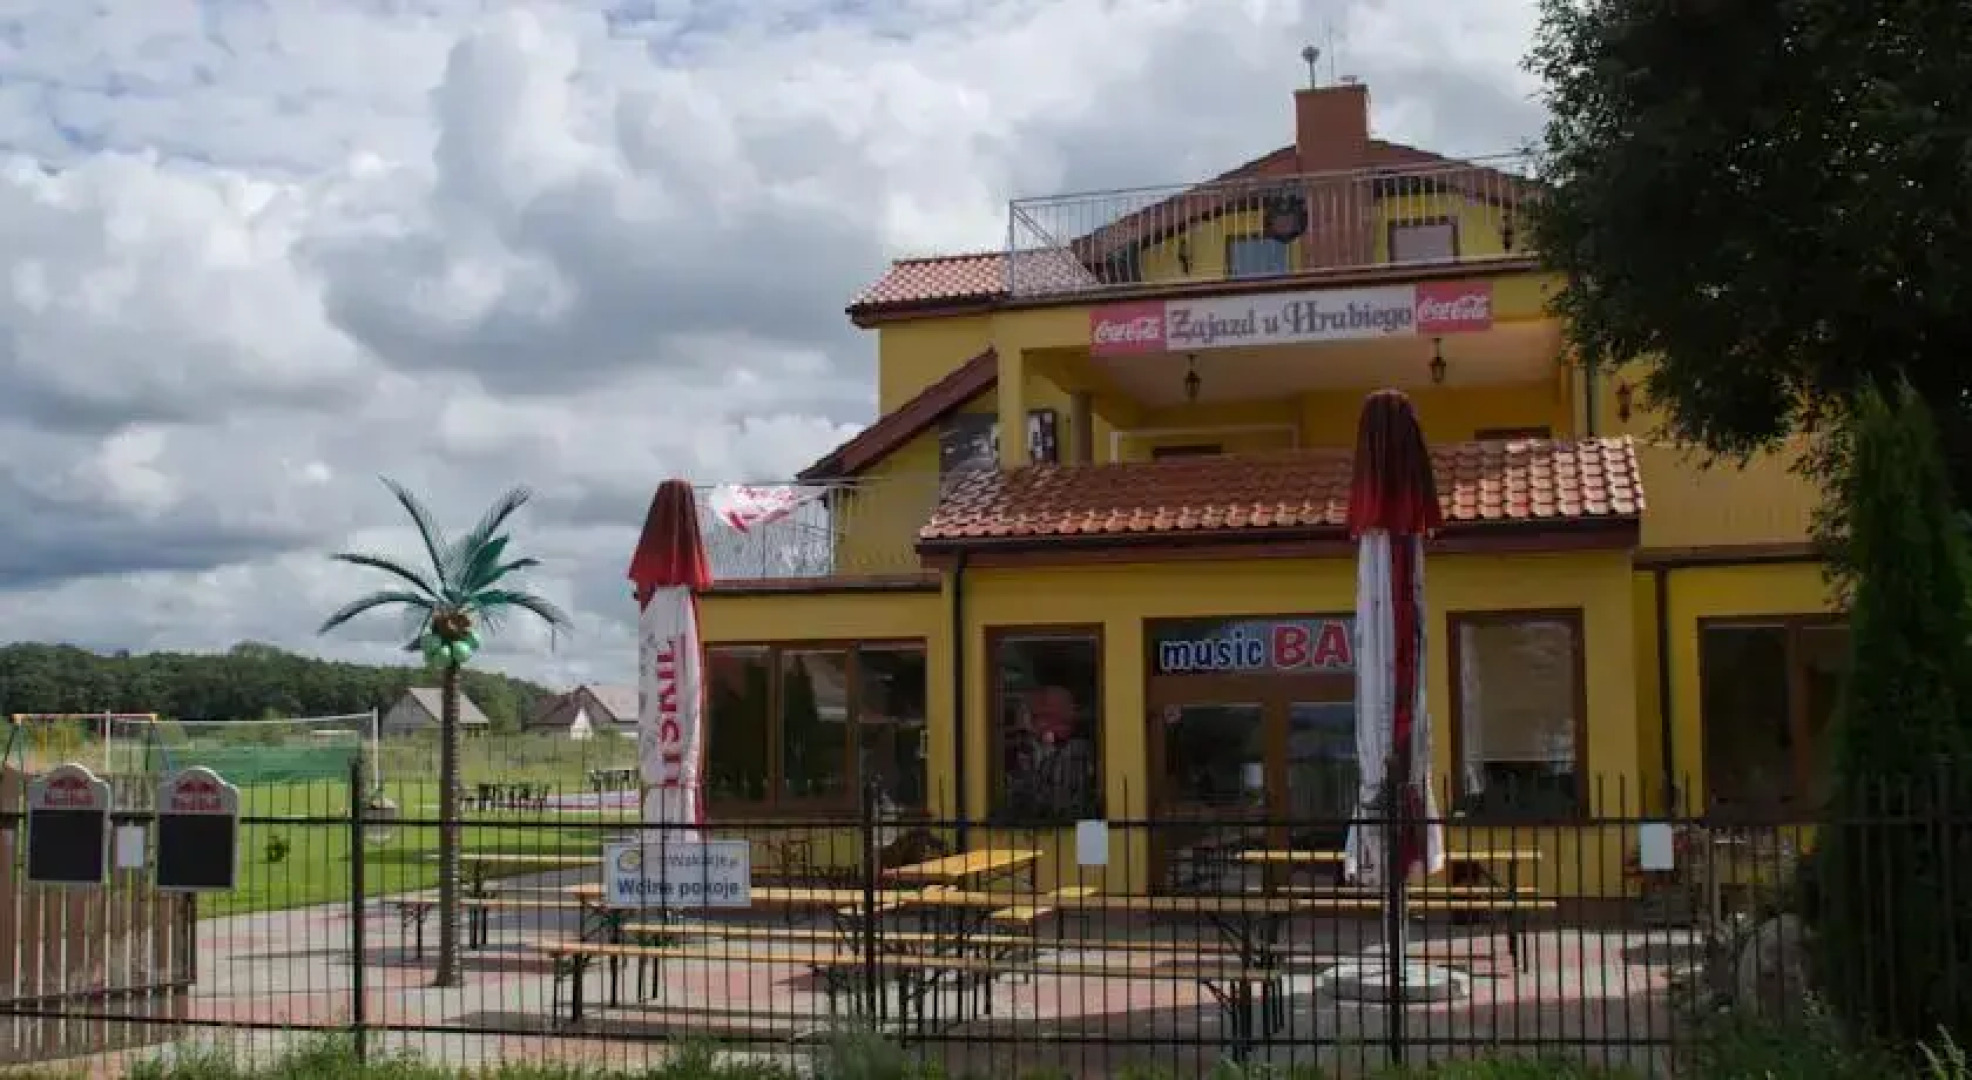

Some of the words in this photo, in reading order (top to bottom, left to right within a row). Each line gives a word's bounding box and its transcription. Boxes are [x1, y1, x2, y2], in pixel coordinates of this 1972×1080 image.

[1170, 308, 1257, 343] Zajazd
[1264, 316, 1281, 335] u
[1283, 299, 1411, 335] Hrubiego
[1160, 630, 1264, 670] music
[1271, 620, 1353, 668] BA
